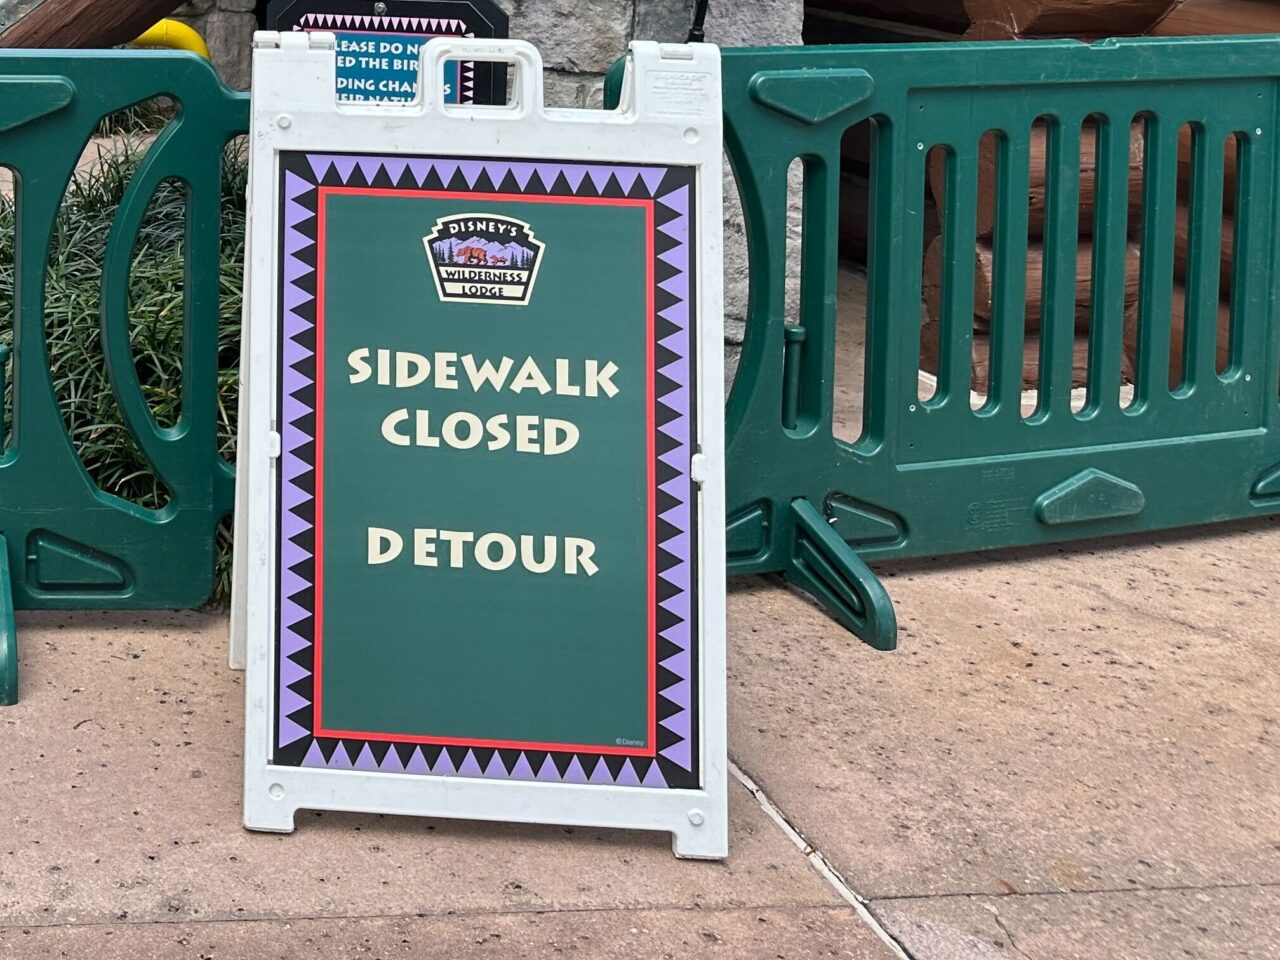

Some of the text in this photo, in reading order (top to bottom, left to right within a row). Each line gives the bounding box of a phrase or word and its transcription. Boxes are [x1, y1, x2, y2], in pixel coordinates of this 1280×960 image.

[335, 40, 376, 52] LEASE
[380, 43, 403, 54] DO
[337, 56, 419, 71] ED THE BIR
[337, 78, 375, 90] DING
[448, 221, 518, 237] DISNEY'S
[445, 270, 523, 282] WILDERNESS
[462, 285, 504, 296] LODGE
[347, 347, 620, 399] SIDEWALK
[381, 408, 580, 456] CLOSED
[367, 526, 600, 577] DETOUR
